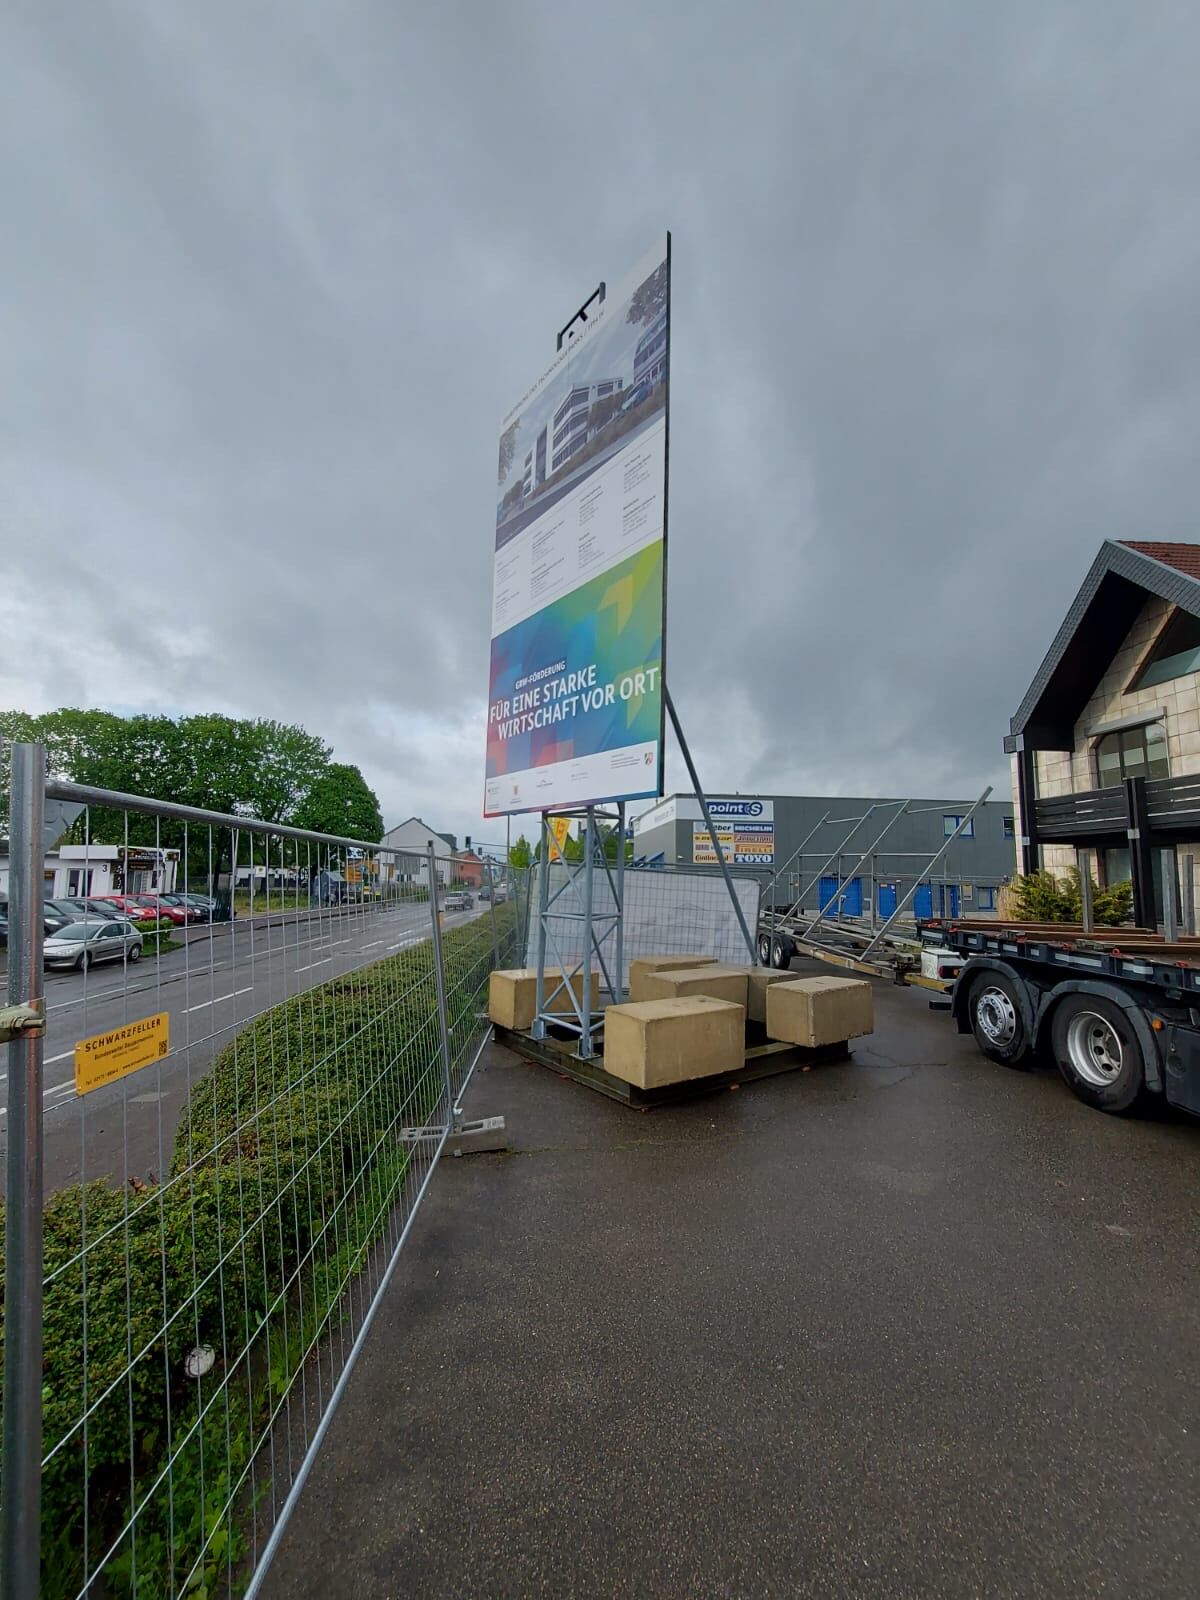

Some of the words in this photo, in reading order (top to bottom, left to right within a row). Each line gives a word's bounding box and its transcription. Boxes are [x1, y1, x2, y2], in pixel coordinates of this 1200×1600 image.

[515, 660, 566, 690] GRW-FÖRDERUNG
[490, 699, 510, 724] FÜR
[512, 687, 541, 714] EINE
[543, 664, 597, 703] STARKE
[498, 695, 580, 741] WIRTSCHAFT
[582, 683, 615, 713] VOR
[620, 667, 659, 700] ORT
[708, 803, 743, 813] point
[102, 864, 108, 873] 3
[695, 854, 729, 863] Contineal
[735, 854, 772, 863] TOYO
[85, 1018, 161, 1053] SCHWARZFELLER
